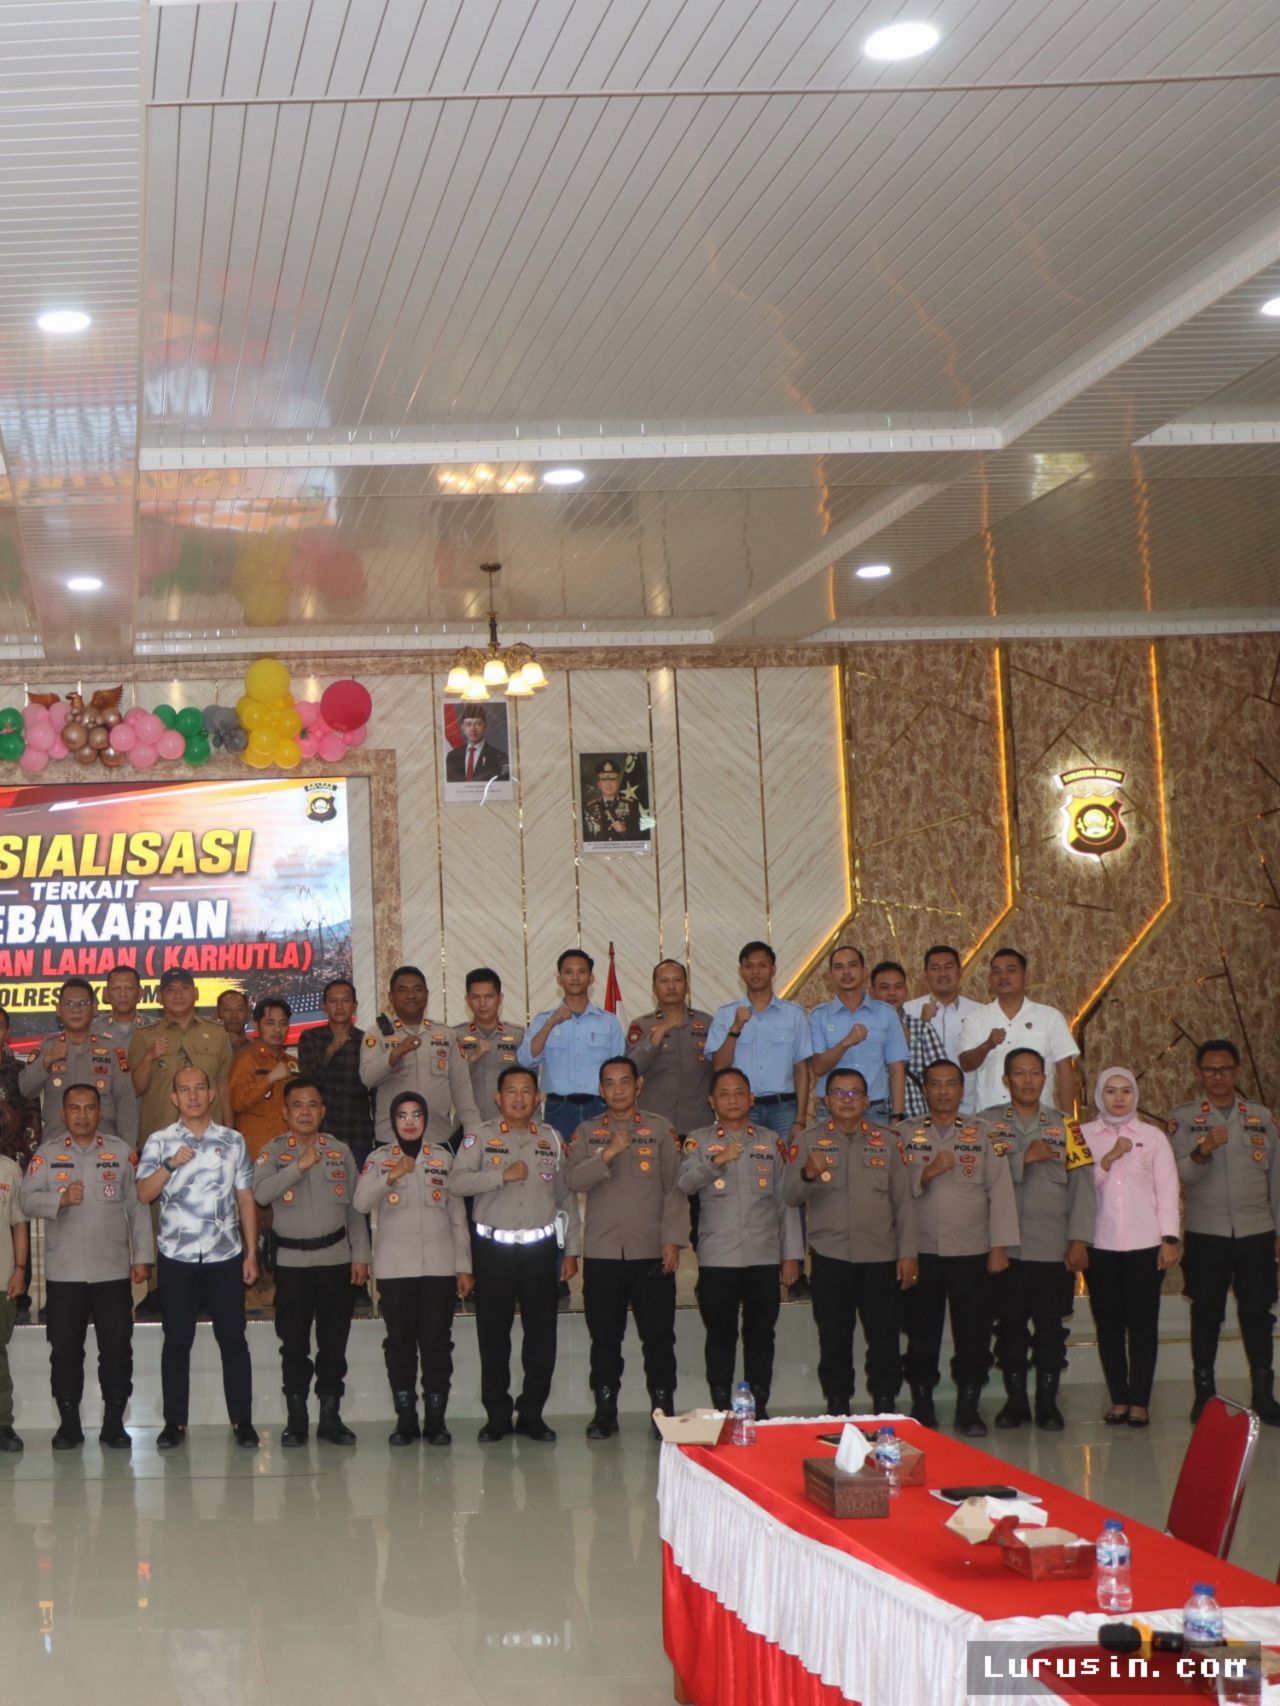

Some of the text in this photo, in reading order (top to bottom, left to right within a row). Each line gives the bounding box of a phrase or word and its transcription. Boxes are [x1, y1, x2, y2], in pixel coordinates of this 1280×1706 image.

[30, 879, 139, 901] TERKAIT
[42, 946, 137, 976] LAHAN
[953, 1144, 982, 1152] POLRI
